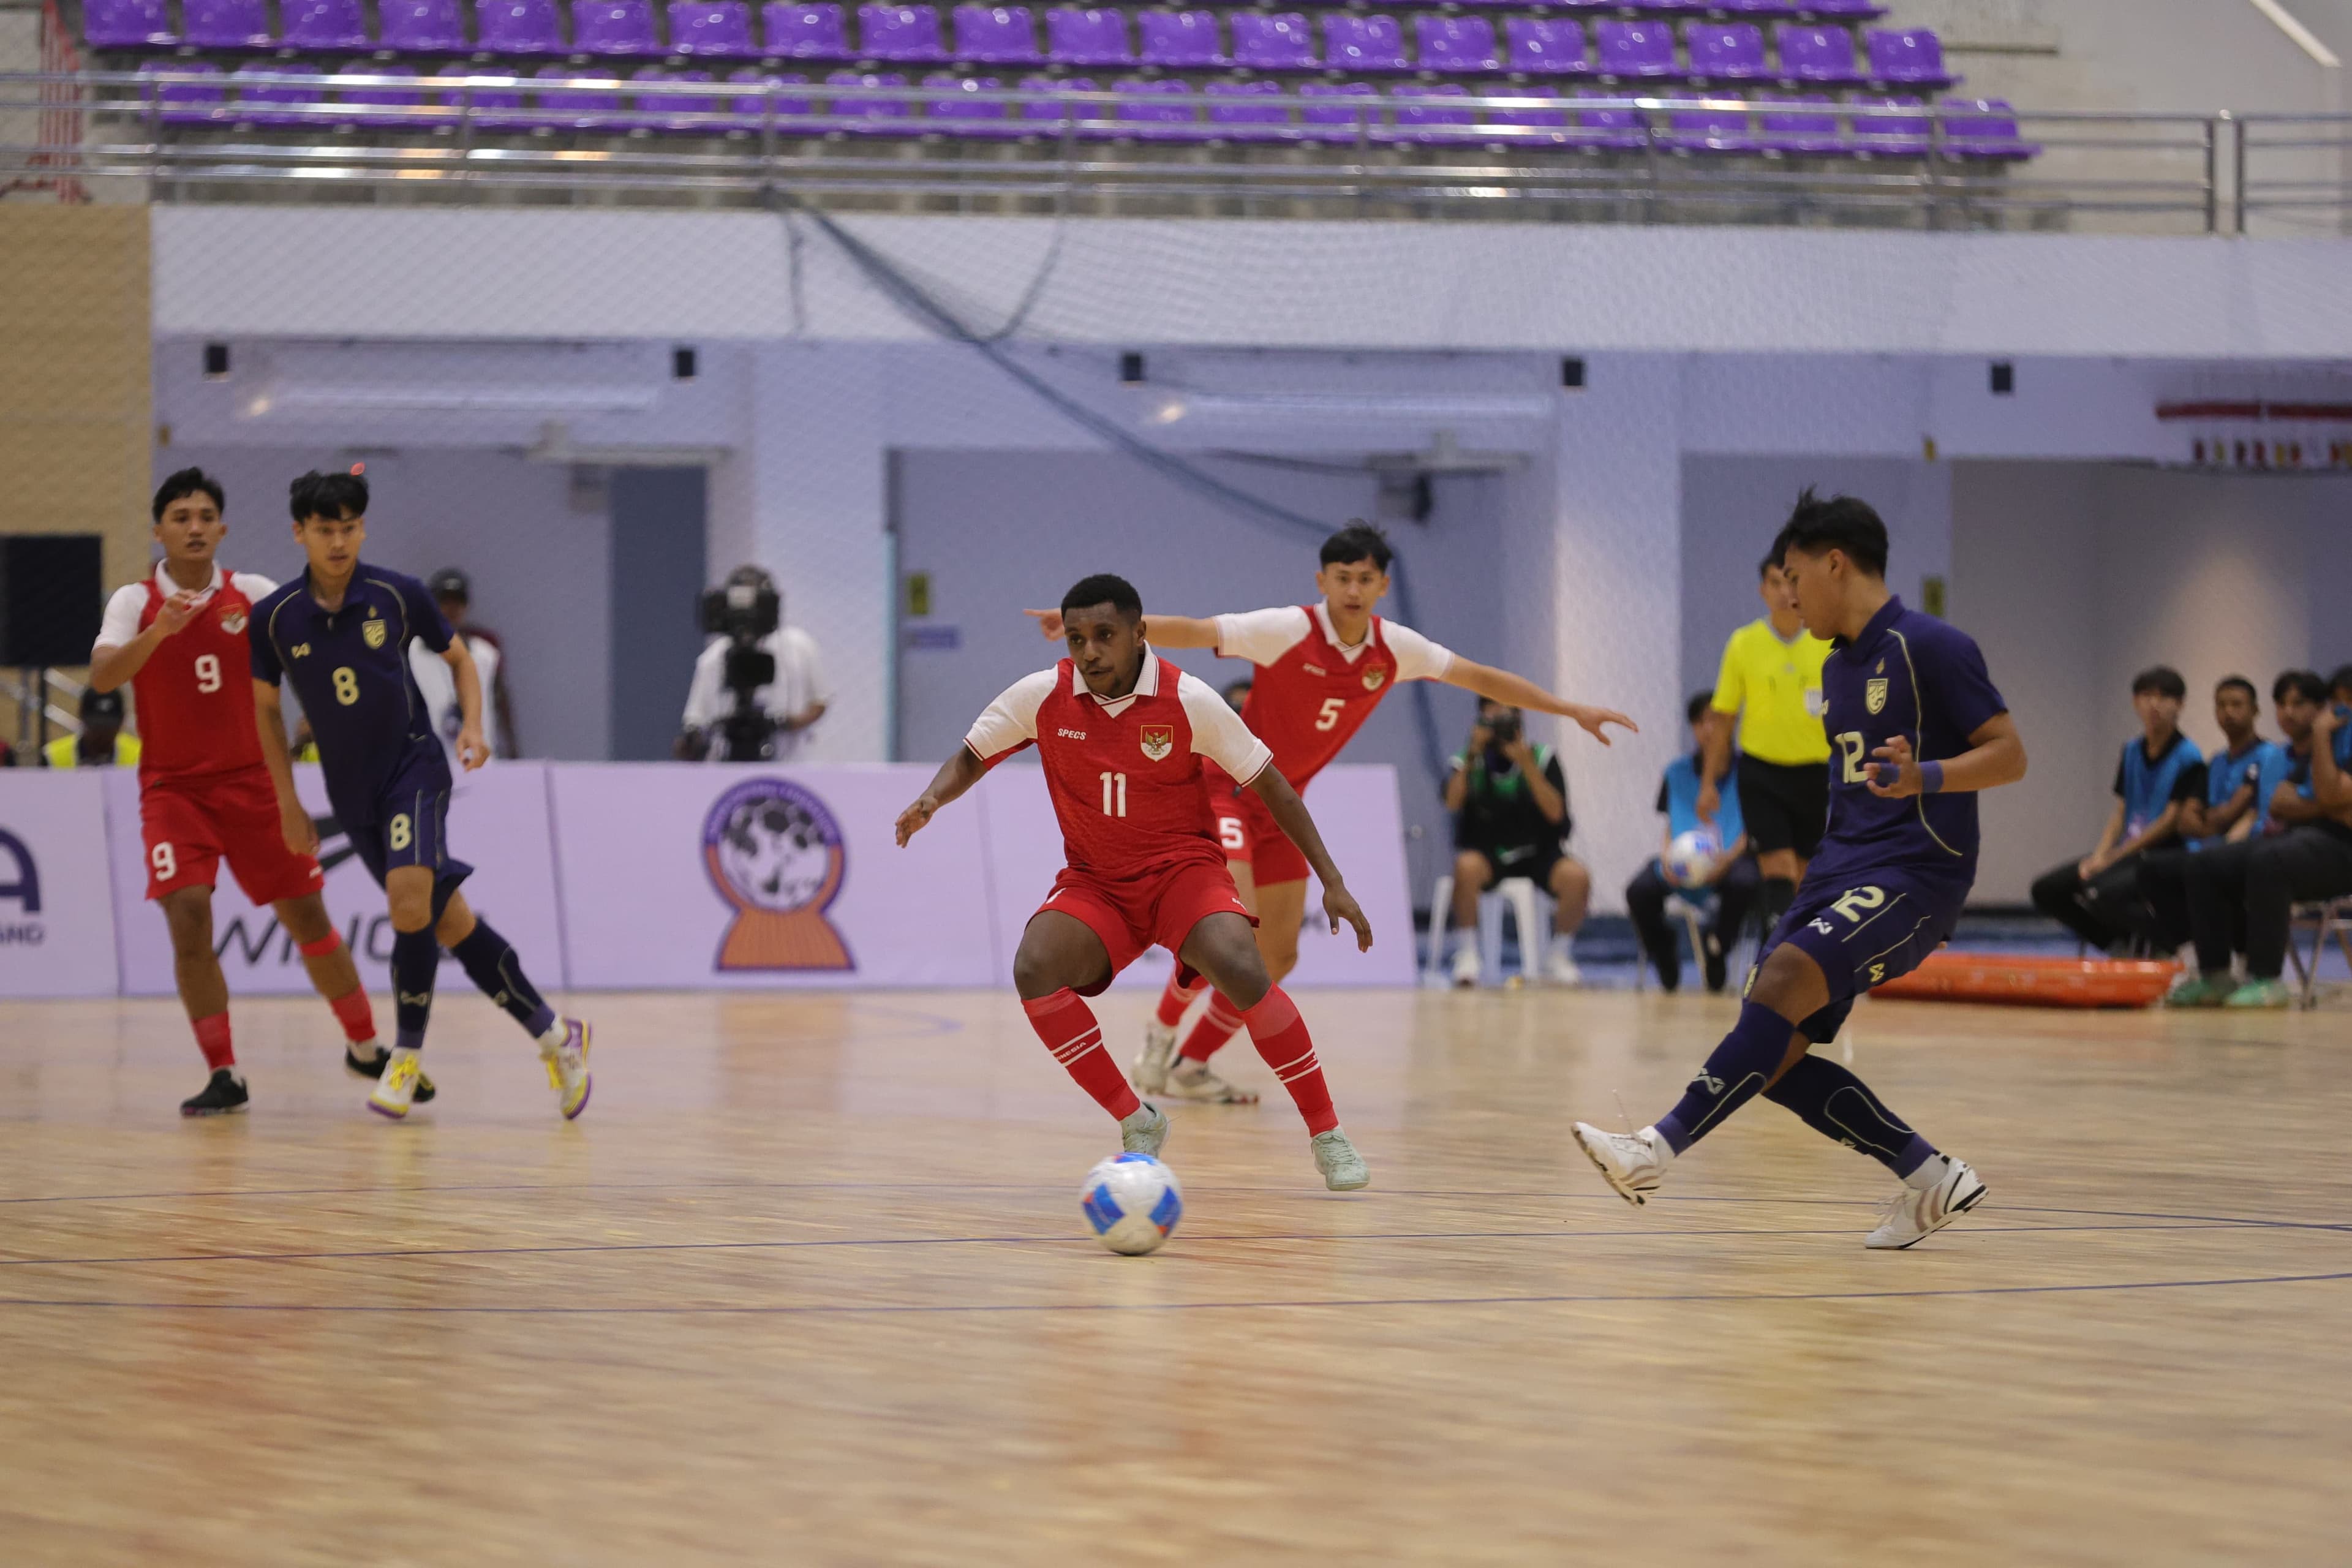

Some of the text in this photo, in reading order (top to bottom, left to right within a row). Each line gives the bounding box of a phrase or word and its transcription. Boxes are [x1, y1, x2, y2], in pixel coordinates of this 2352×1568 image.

[195, 653, 222, 694] 9
[333, 666, 360, 706] 8
[1058, 728, 1086, 740] SPECS
[1314, 697, 1346, 731] 5
[1834, 731, 1869, 784] 12
[1099, 771, 1126, 818] 11
[390, 813, 412, 851] 8
[1219, 816, 1245, 850] 5
[151, 841, 176, 882] 9
